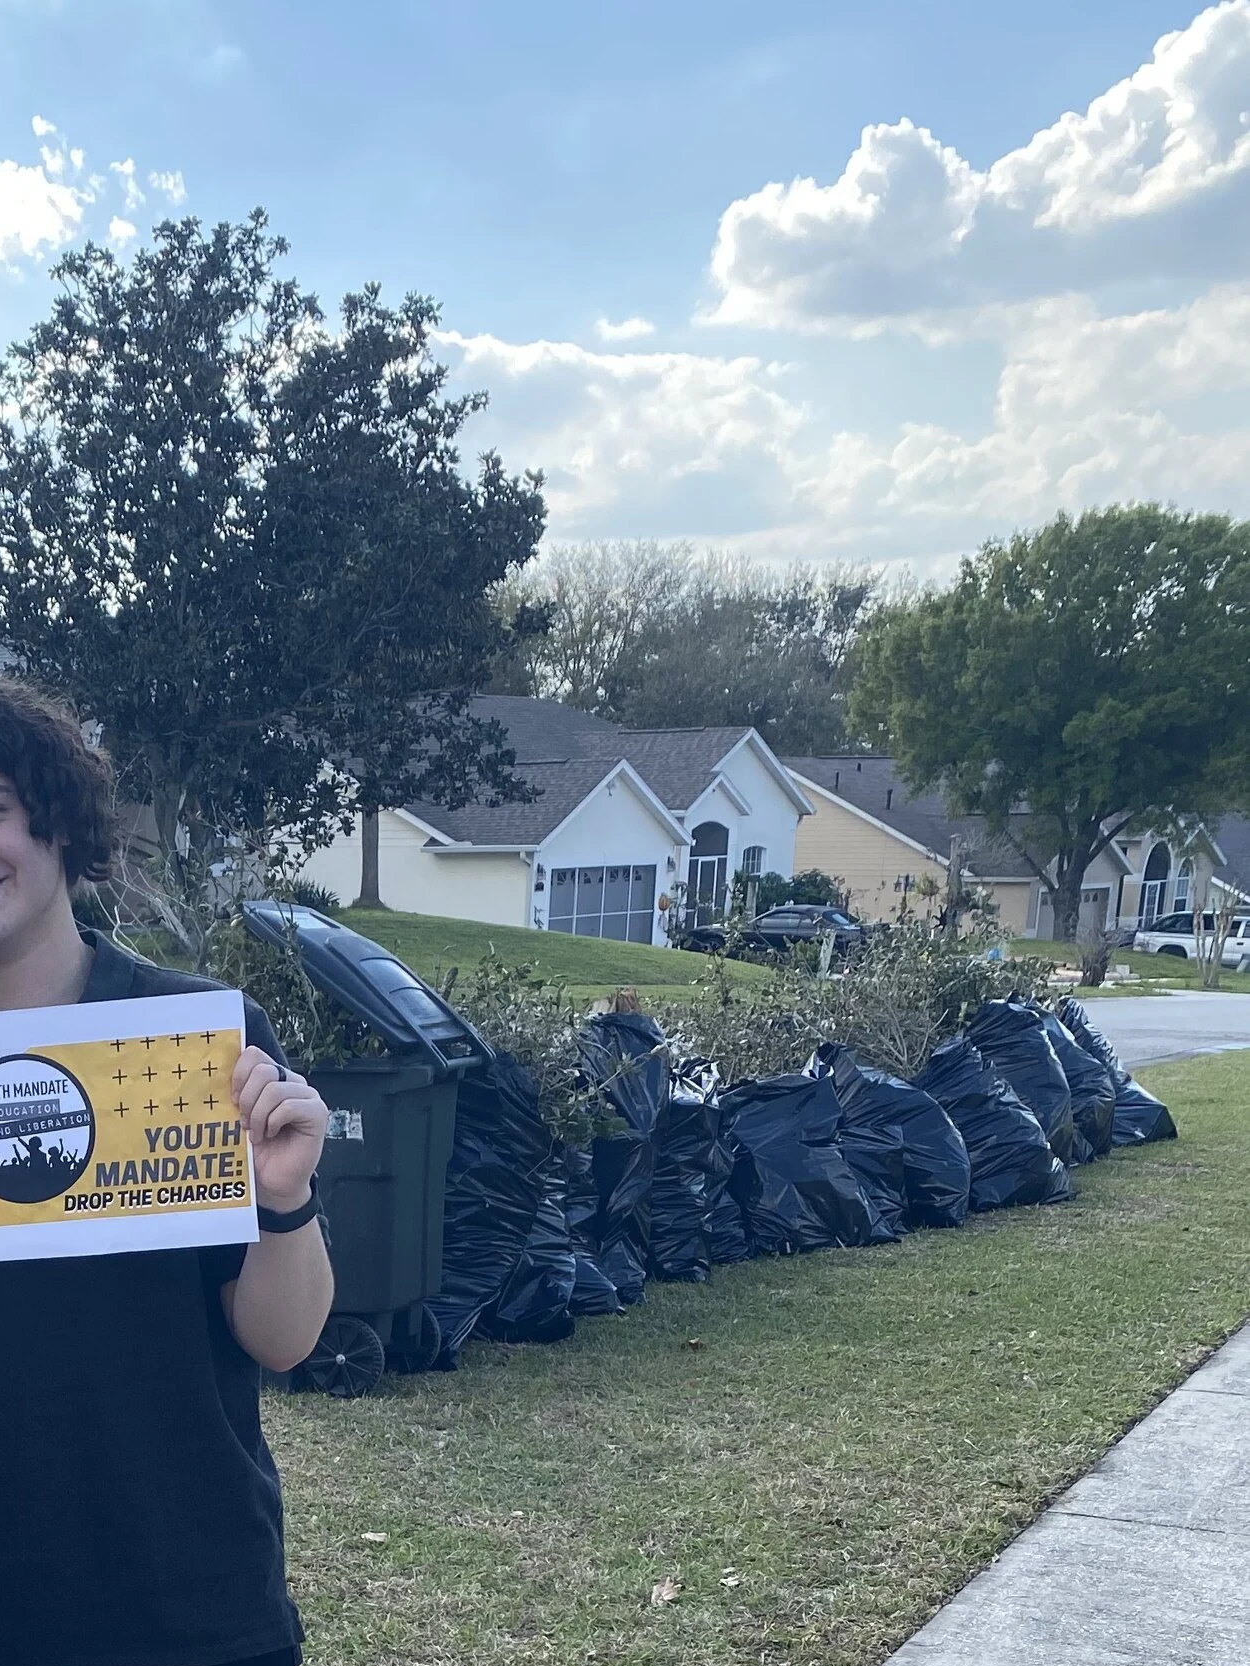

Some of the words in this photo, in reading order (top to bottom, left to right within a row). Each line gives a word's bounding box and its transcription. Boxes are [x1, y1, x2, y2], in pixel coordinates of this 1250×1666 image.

[14, 1079, 69, 1097] MANDATE
[19, 1113, 90, 1133] LIBERATION
[144, 1120, 241, 1153] YOUTH
[96, 1151, 243, 1188] MANDATE:
[64, 1191, 114, 1213] DROP
[118, 1188, 153, 1208] THE
[156, 1180, 246, 1206] CHARGES
